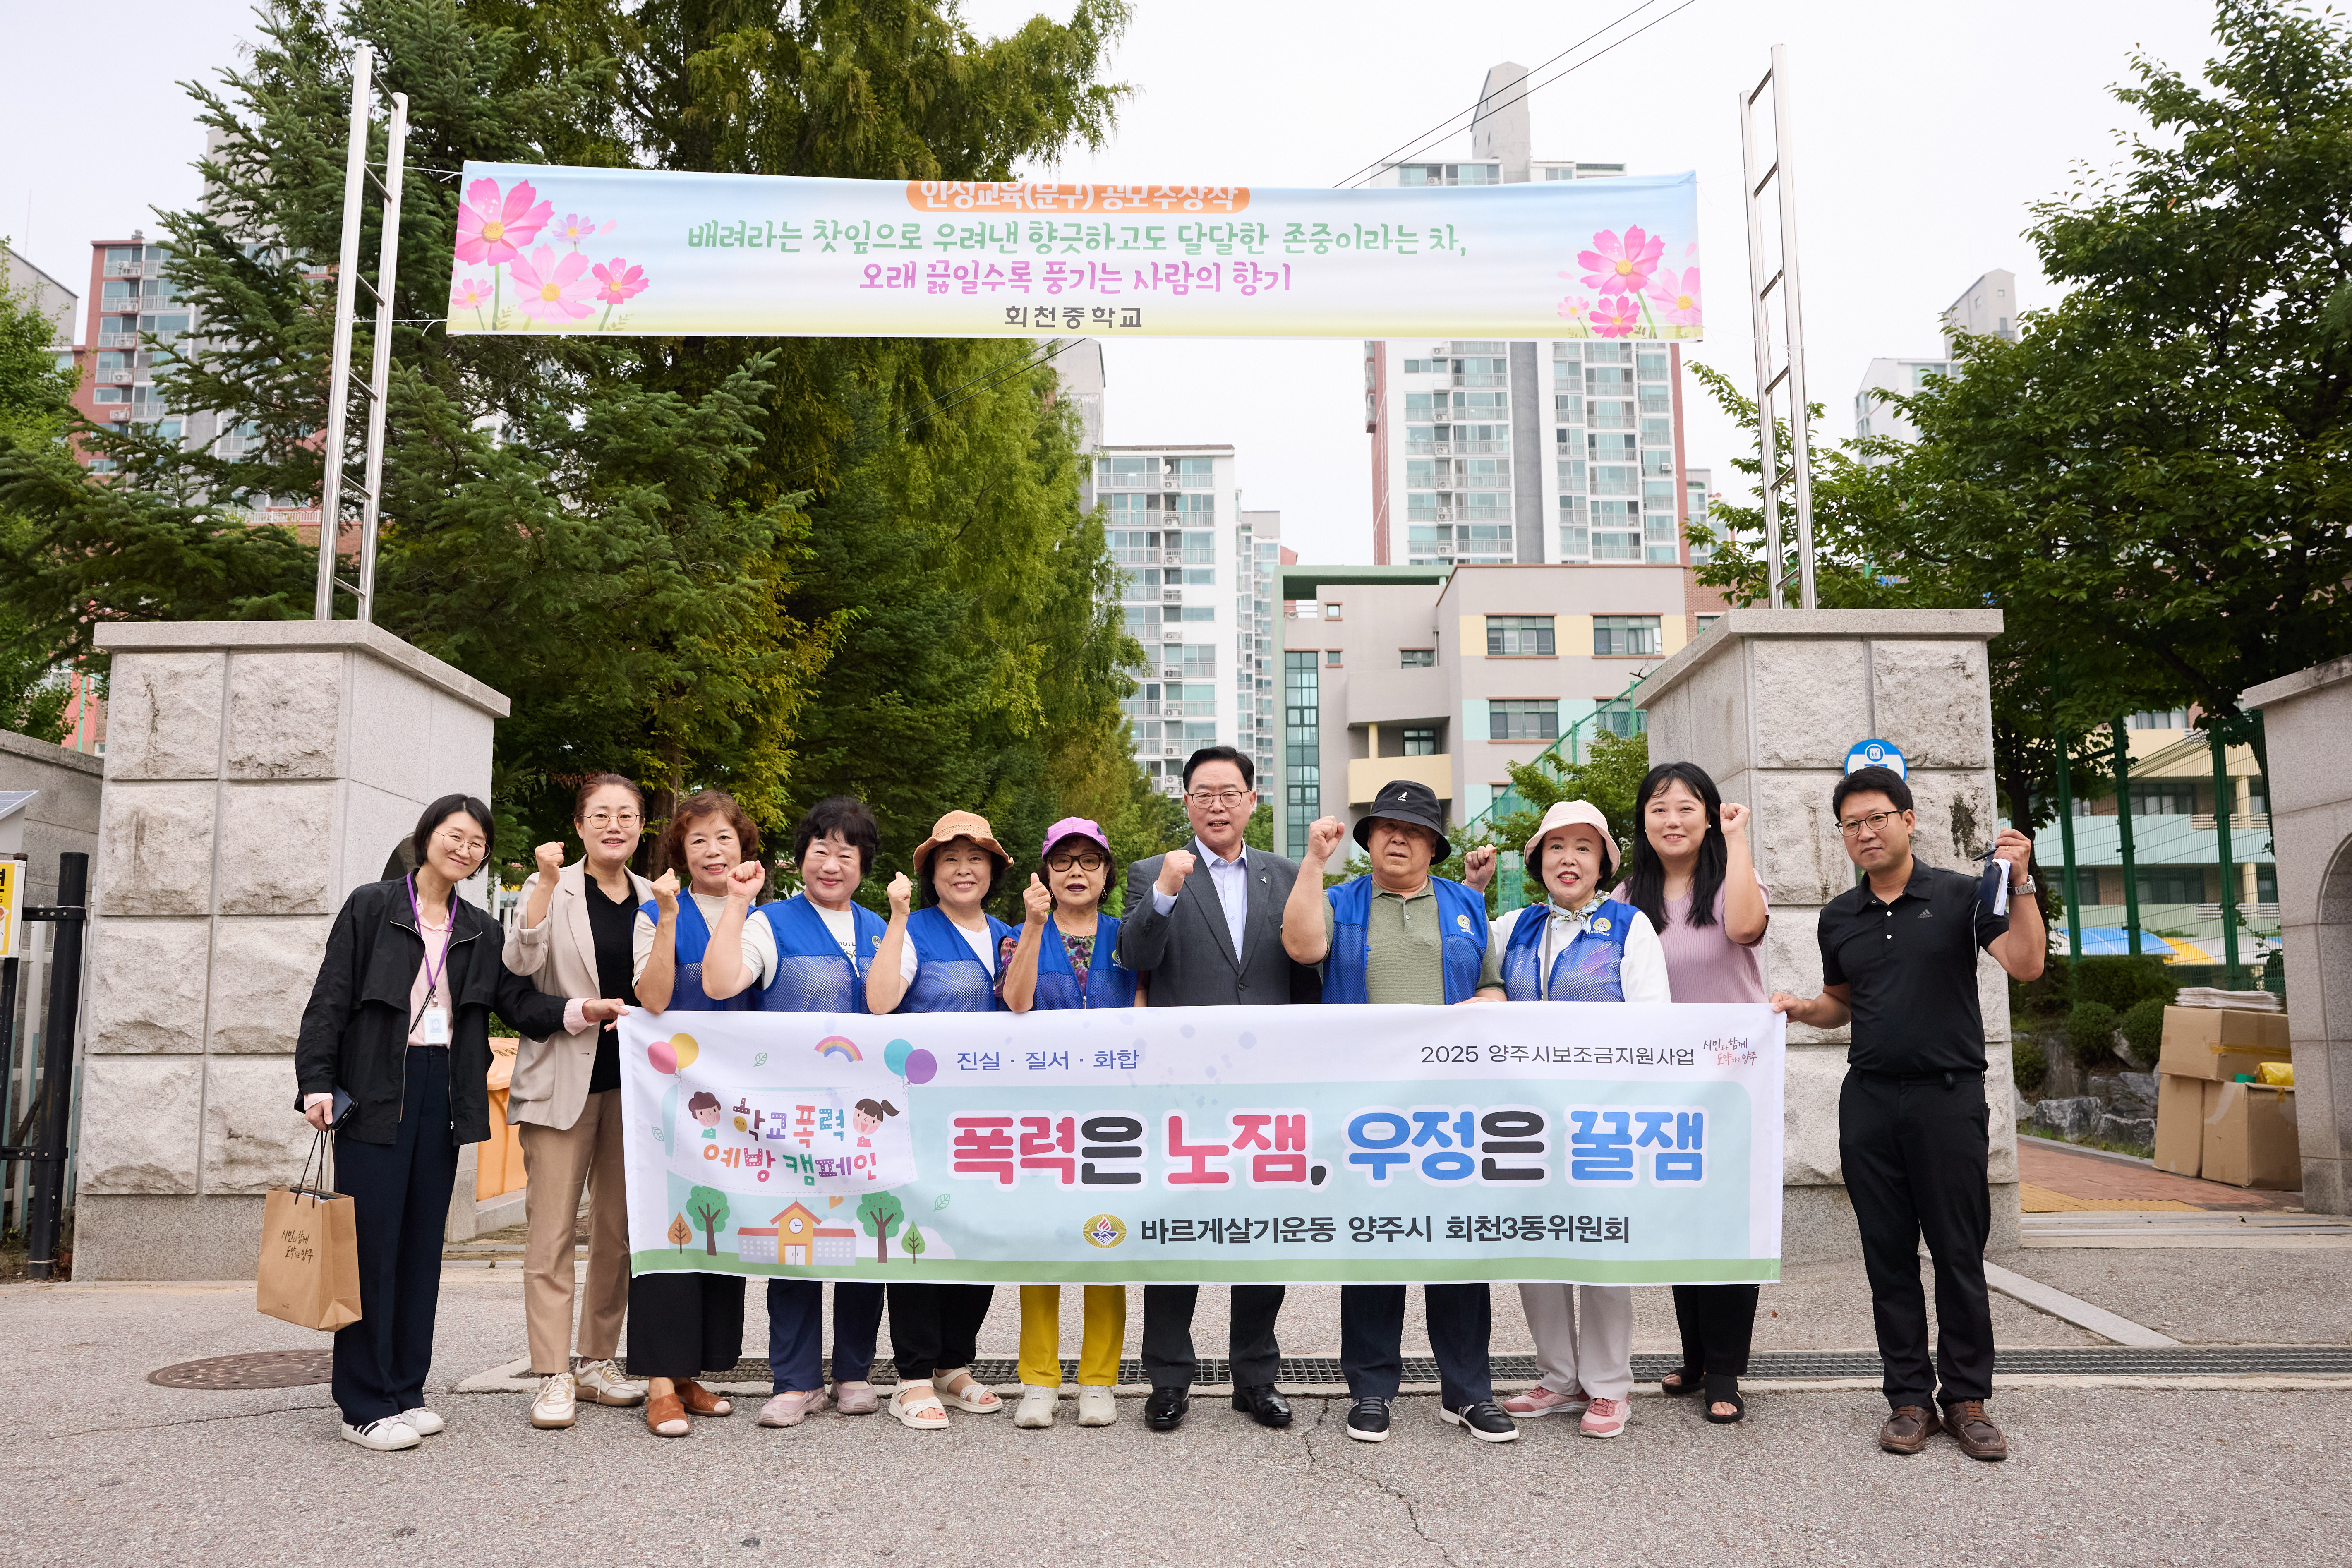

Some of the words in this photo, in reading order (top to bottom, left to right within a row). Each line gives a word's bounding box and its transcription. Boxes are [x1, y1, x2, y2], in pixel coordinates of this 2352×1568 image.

[688, 219, 802, 252] 배려라는
[813, 219, 922, 254] 찻잎으로
[933, 221, 1018, 254] 우려낸
[1028, 221, 1167, 254] 향긋하고도
[1178, 222, 1269, 255] 달달한
[1283, 223, 1419, 254] 존중이라는
[1429, 223, 1466, 256] 차,
[859, 260, 916, 288] 오래
[926, 259, 1032, 295] 끓일수록
[1043, 261, 1122, 295] 풍기는
[1133, 261, 1221, 295] 사람의
[1233, 261, 1290, 296] 향기
[1005, 305, 1142, 329] 회천중학교
[956, 1051, 1000, 1071] 진실
[1024, 1050, 1069, 1071] 질서
[1093, 1049, 1140, 1070] 화합
[1421, 1045, 1479, 1063] 2025
[1489, 1045, 1695, 1066] 양주시보조금지원사업
[1742, 1050, 1757, 1066] 양주
[954, 1116, 1142, 1185] 폭력은
[1168, 1114, 1326, 1186] 노잼,
[1347, 1110, 1545, 1181] 우정은
[1571, 1110, 1703, 1181] 꿀잼
[703, 1144, 776, 1182] 예방
[782, 1152, 877, 1186] 캠페인
[1141, 1216, 1336, 1244] 바르게살기운동
[1348, 1215, 1431, 1243] 양주시
[1446, 1214, 1630, 1244] 회천3동위원회
